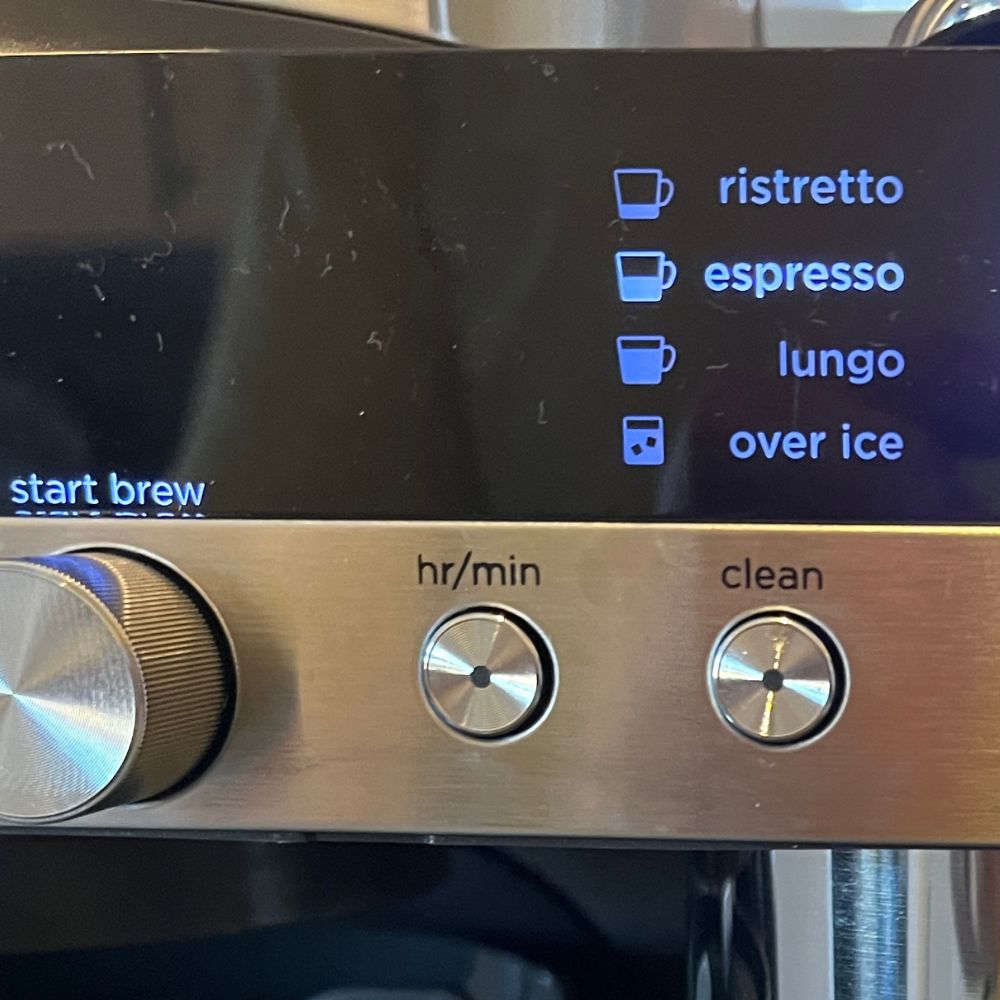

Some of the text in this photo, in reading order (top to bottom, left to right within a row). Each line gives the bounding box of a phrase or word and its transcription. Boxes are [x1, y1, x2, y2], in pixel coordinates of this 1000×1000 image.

[719, 167, 904, 205] ristretto
[703, 261, 905, 298] espresso
[778, 341, 905, 384] lungo
[729, 423, 904, 460] over ice
[9, 472, 205, 506] start brew
[417, 550, 542, 590] hr/min
[721, 558, 824, 591] clean
